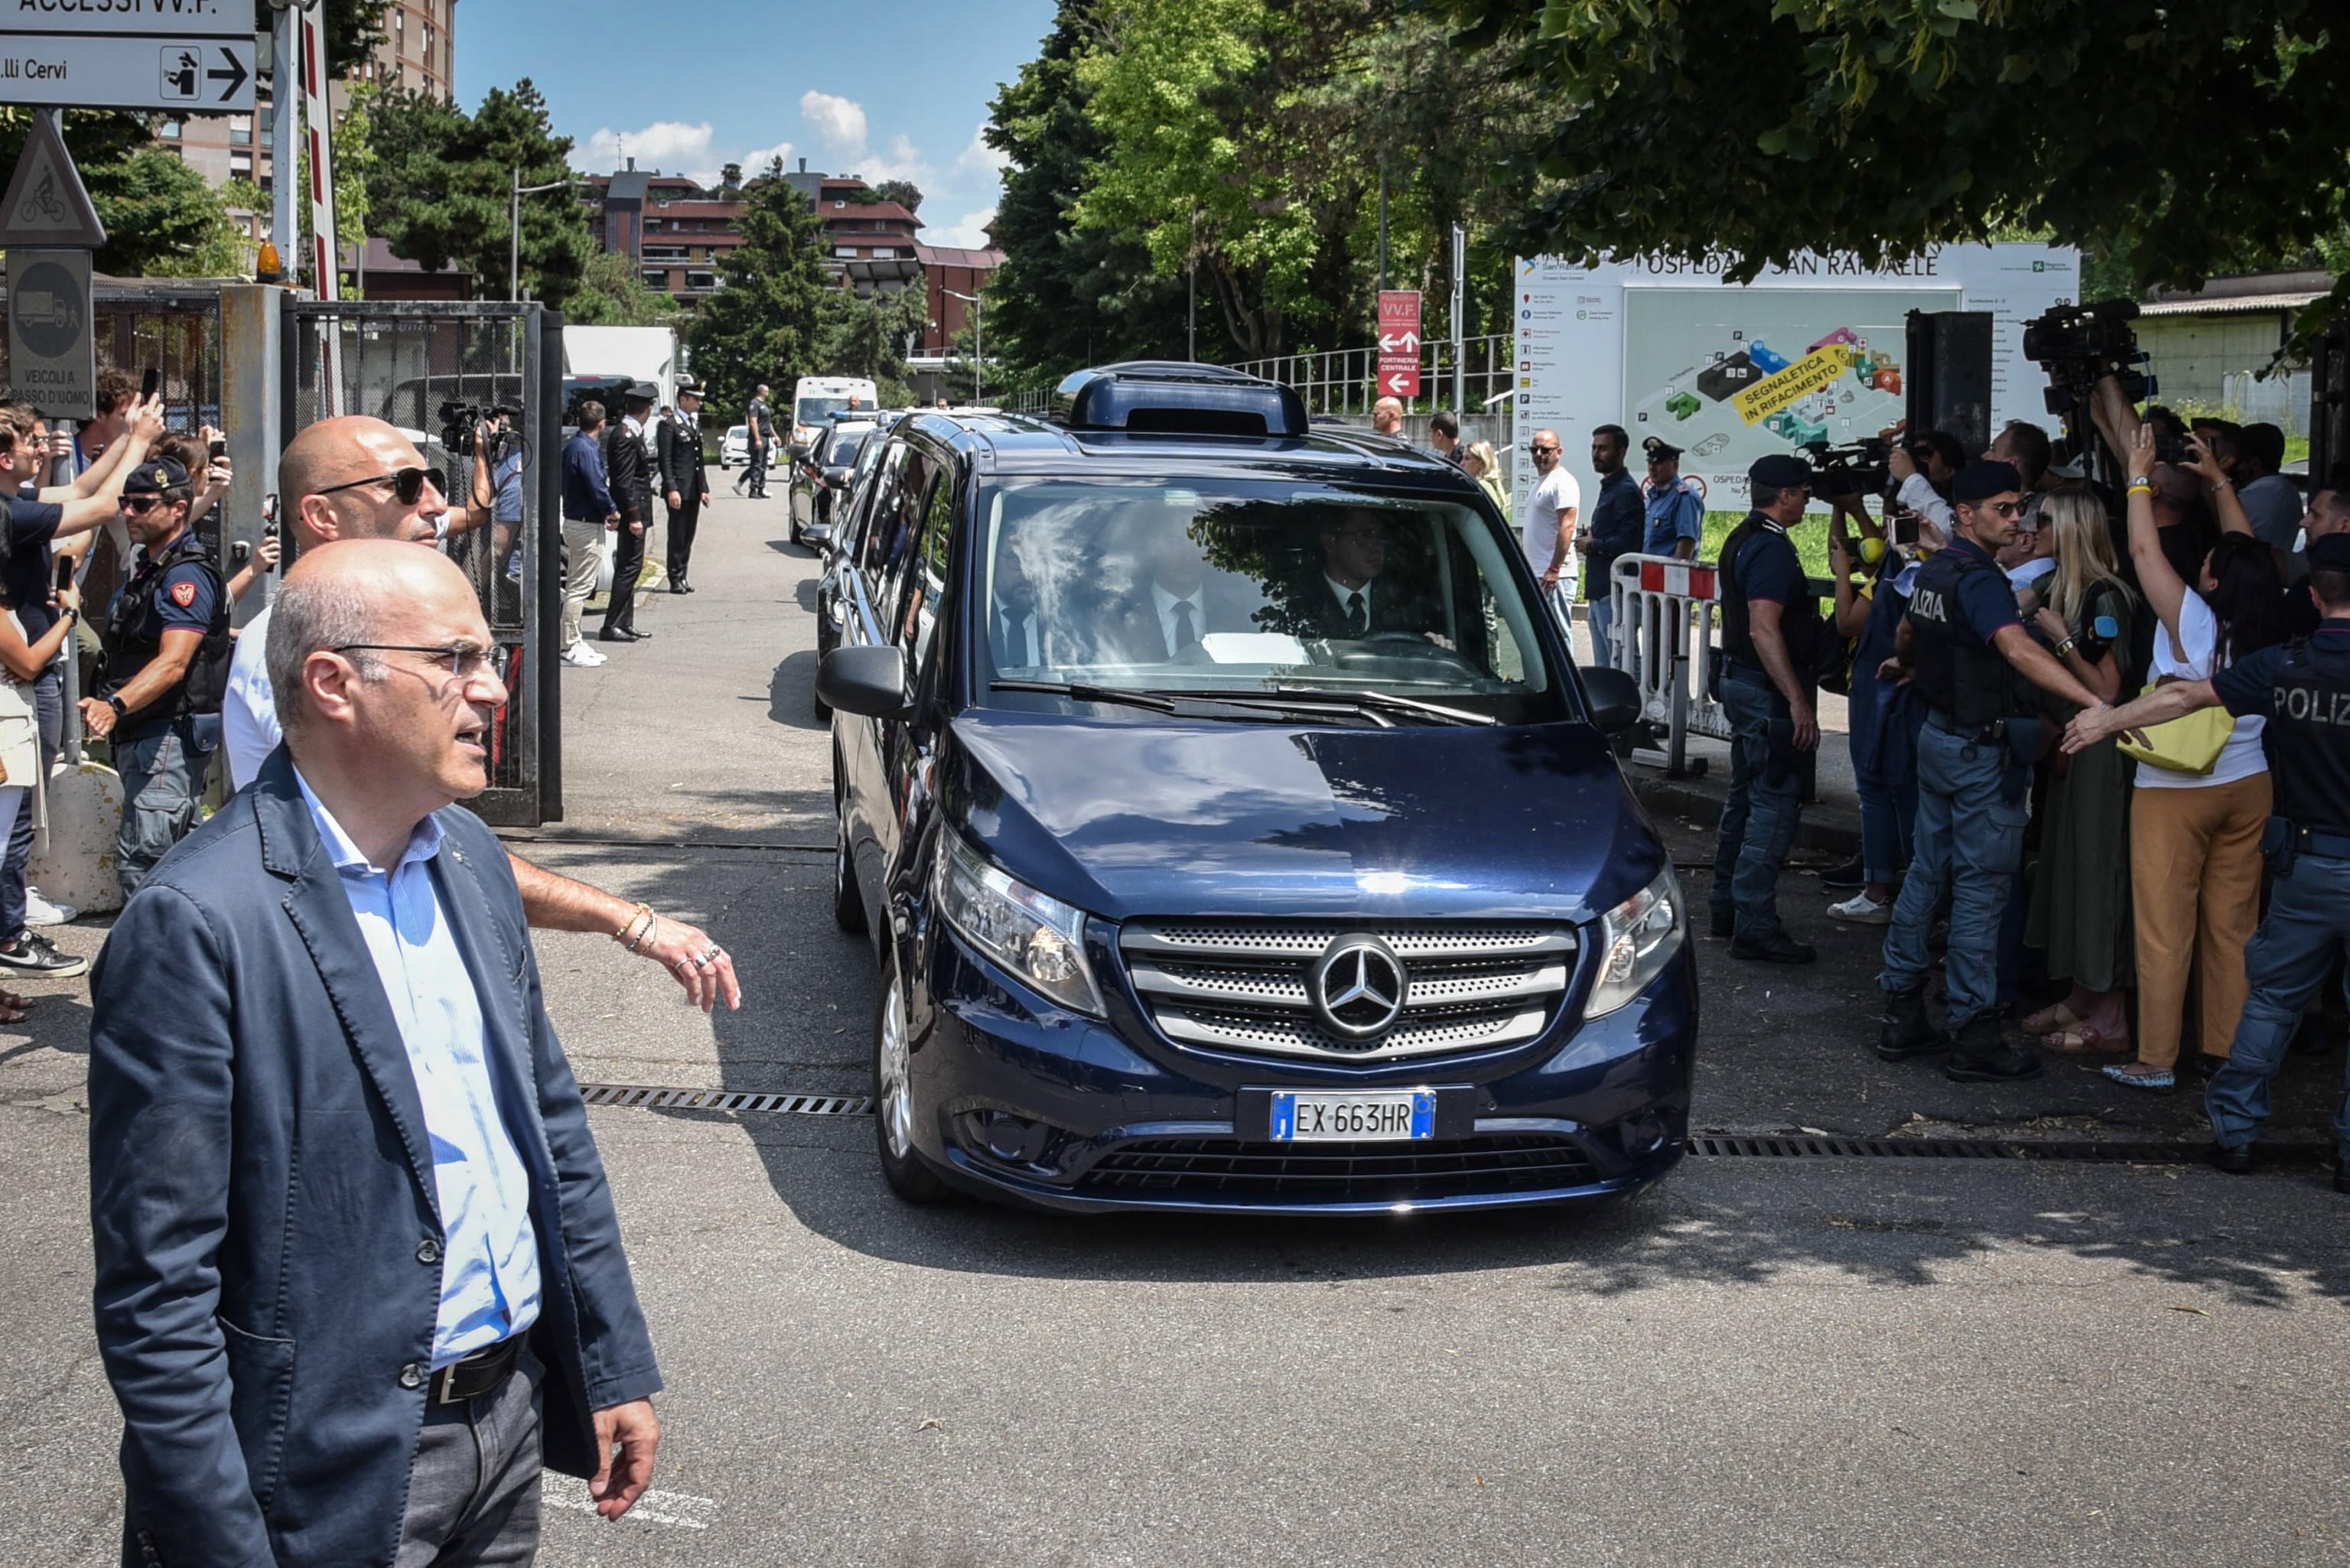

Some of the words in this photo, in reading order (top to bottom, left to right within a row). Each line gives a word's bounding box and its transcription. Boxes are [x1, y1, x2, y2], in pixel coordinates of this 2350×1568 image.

[24, 59, 67, 80] Cervi
[1383, 304, 1416, 316] VV.F.
[24, 370, 65, 385] VEICOLI
[67, 370, 76, 385] A
[1745, 356, 1825, 404] SEGNALETICA
[12, 389, 46, 404] PASSO
[48, 390, 90, 405] D'UOMO
[1745, 408, 1759, 421] IN
[1759, 364, 1838, 416] RIFACIMENTO
